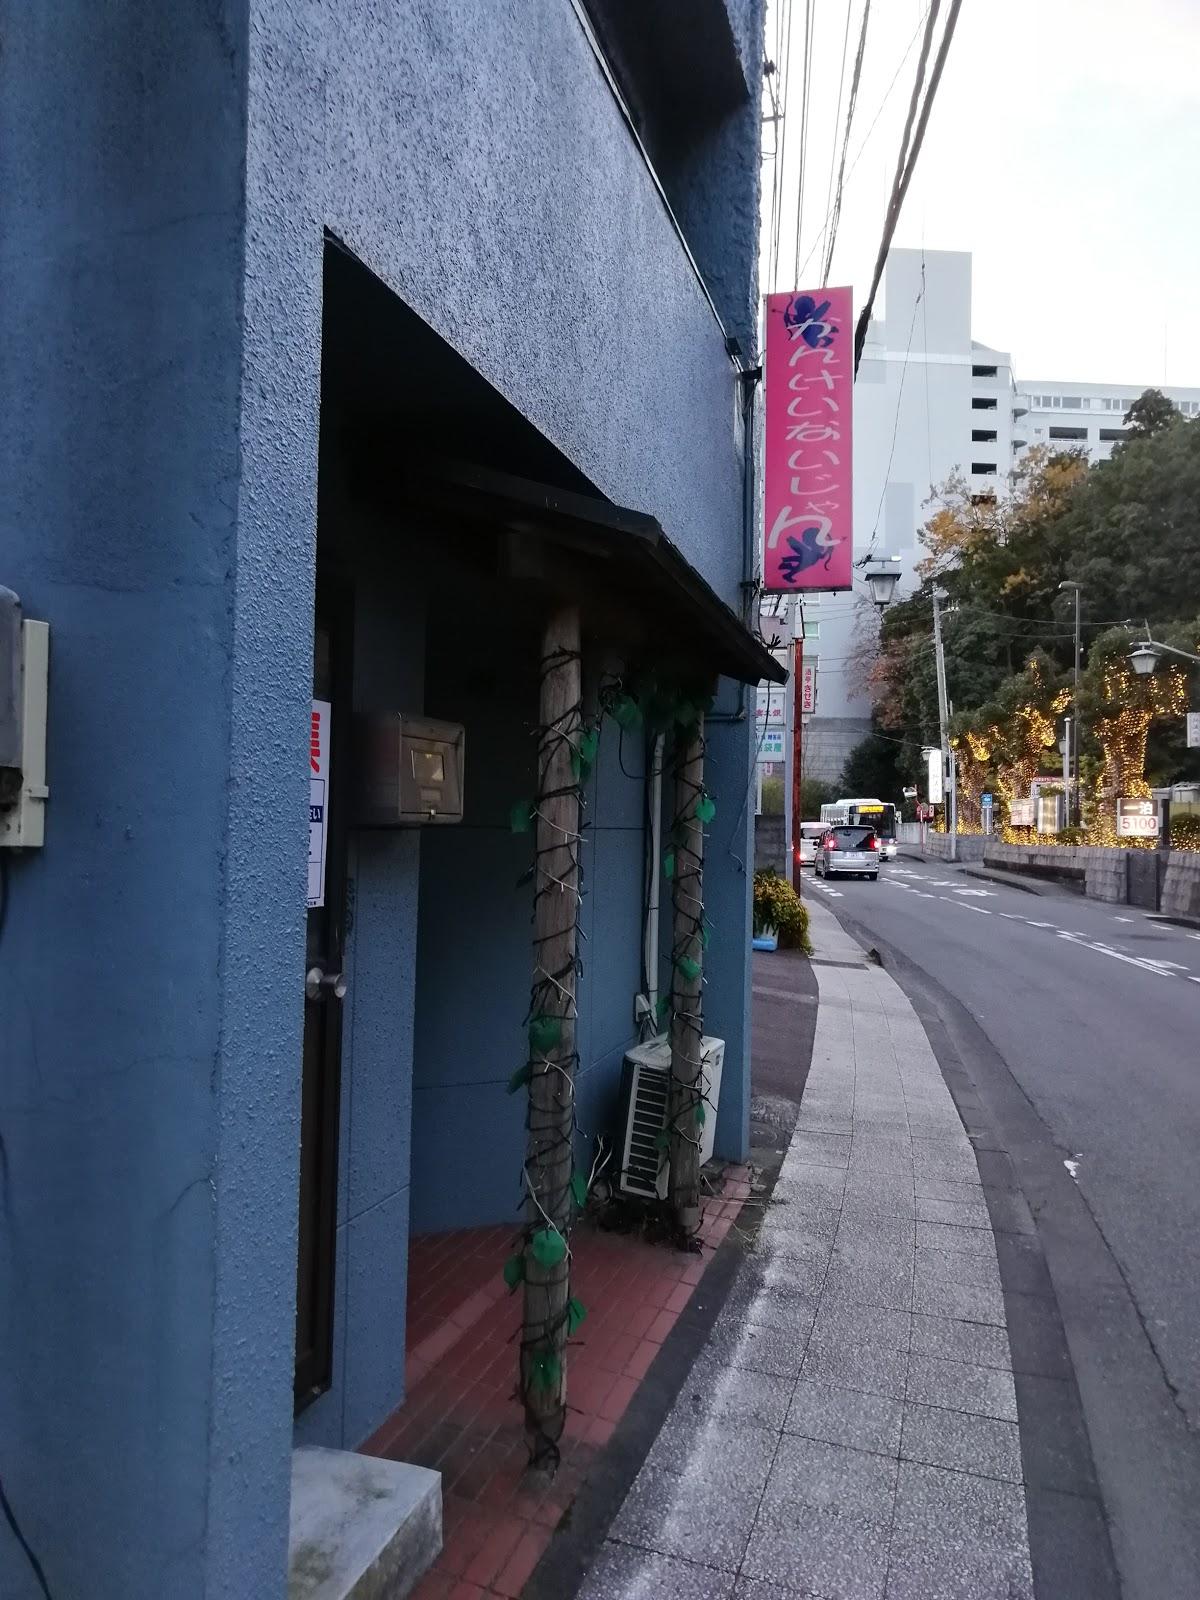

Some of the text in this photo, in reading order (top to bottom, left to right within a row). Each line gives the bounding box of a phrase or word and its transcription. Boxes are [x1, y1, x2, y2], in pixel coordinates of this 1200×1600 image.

[767, 316, 844, 550] かんけいないじゃん
[1123, 801, 1153, 815] 一泊
[1122, 817, 1156, 830] 5100
